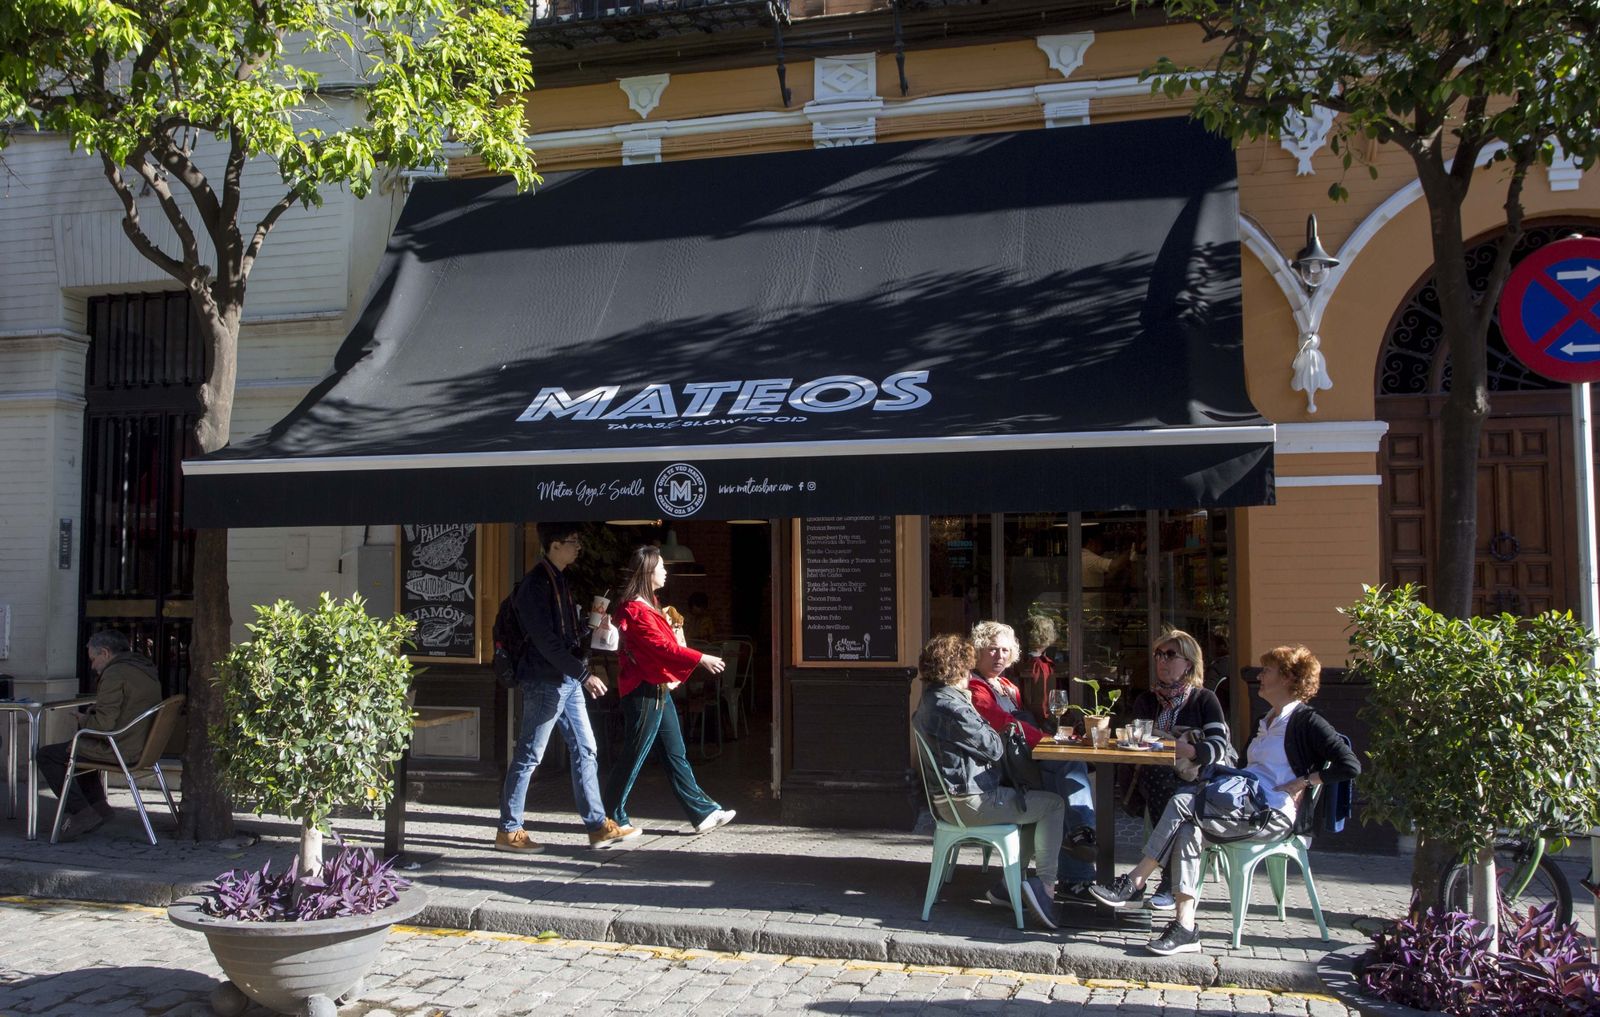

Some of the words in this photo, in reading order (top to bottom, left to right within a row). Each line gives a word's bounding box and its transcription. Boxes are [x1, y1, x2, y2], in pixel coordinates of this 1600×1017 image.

[515, 370, 933, 422] MATEOS
[537, 480, 573, 501] Mateos
[608, 478, 645, 501] Sevilla
[670, 480, 692, 502] M
[420, 523, 460, 543] PAELLA
[414, 605, 465, 621] JAMÓN
